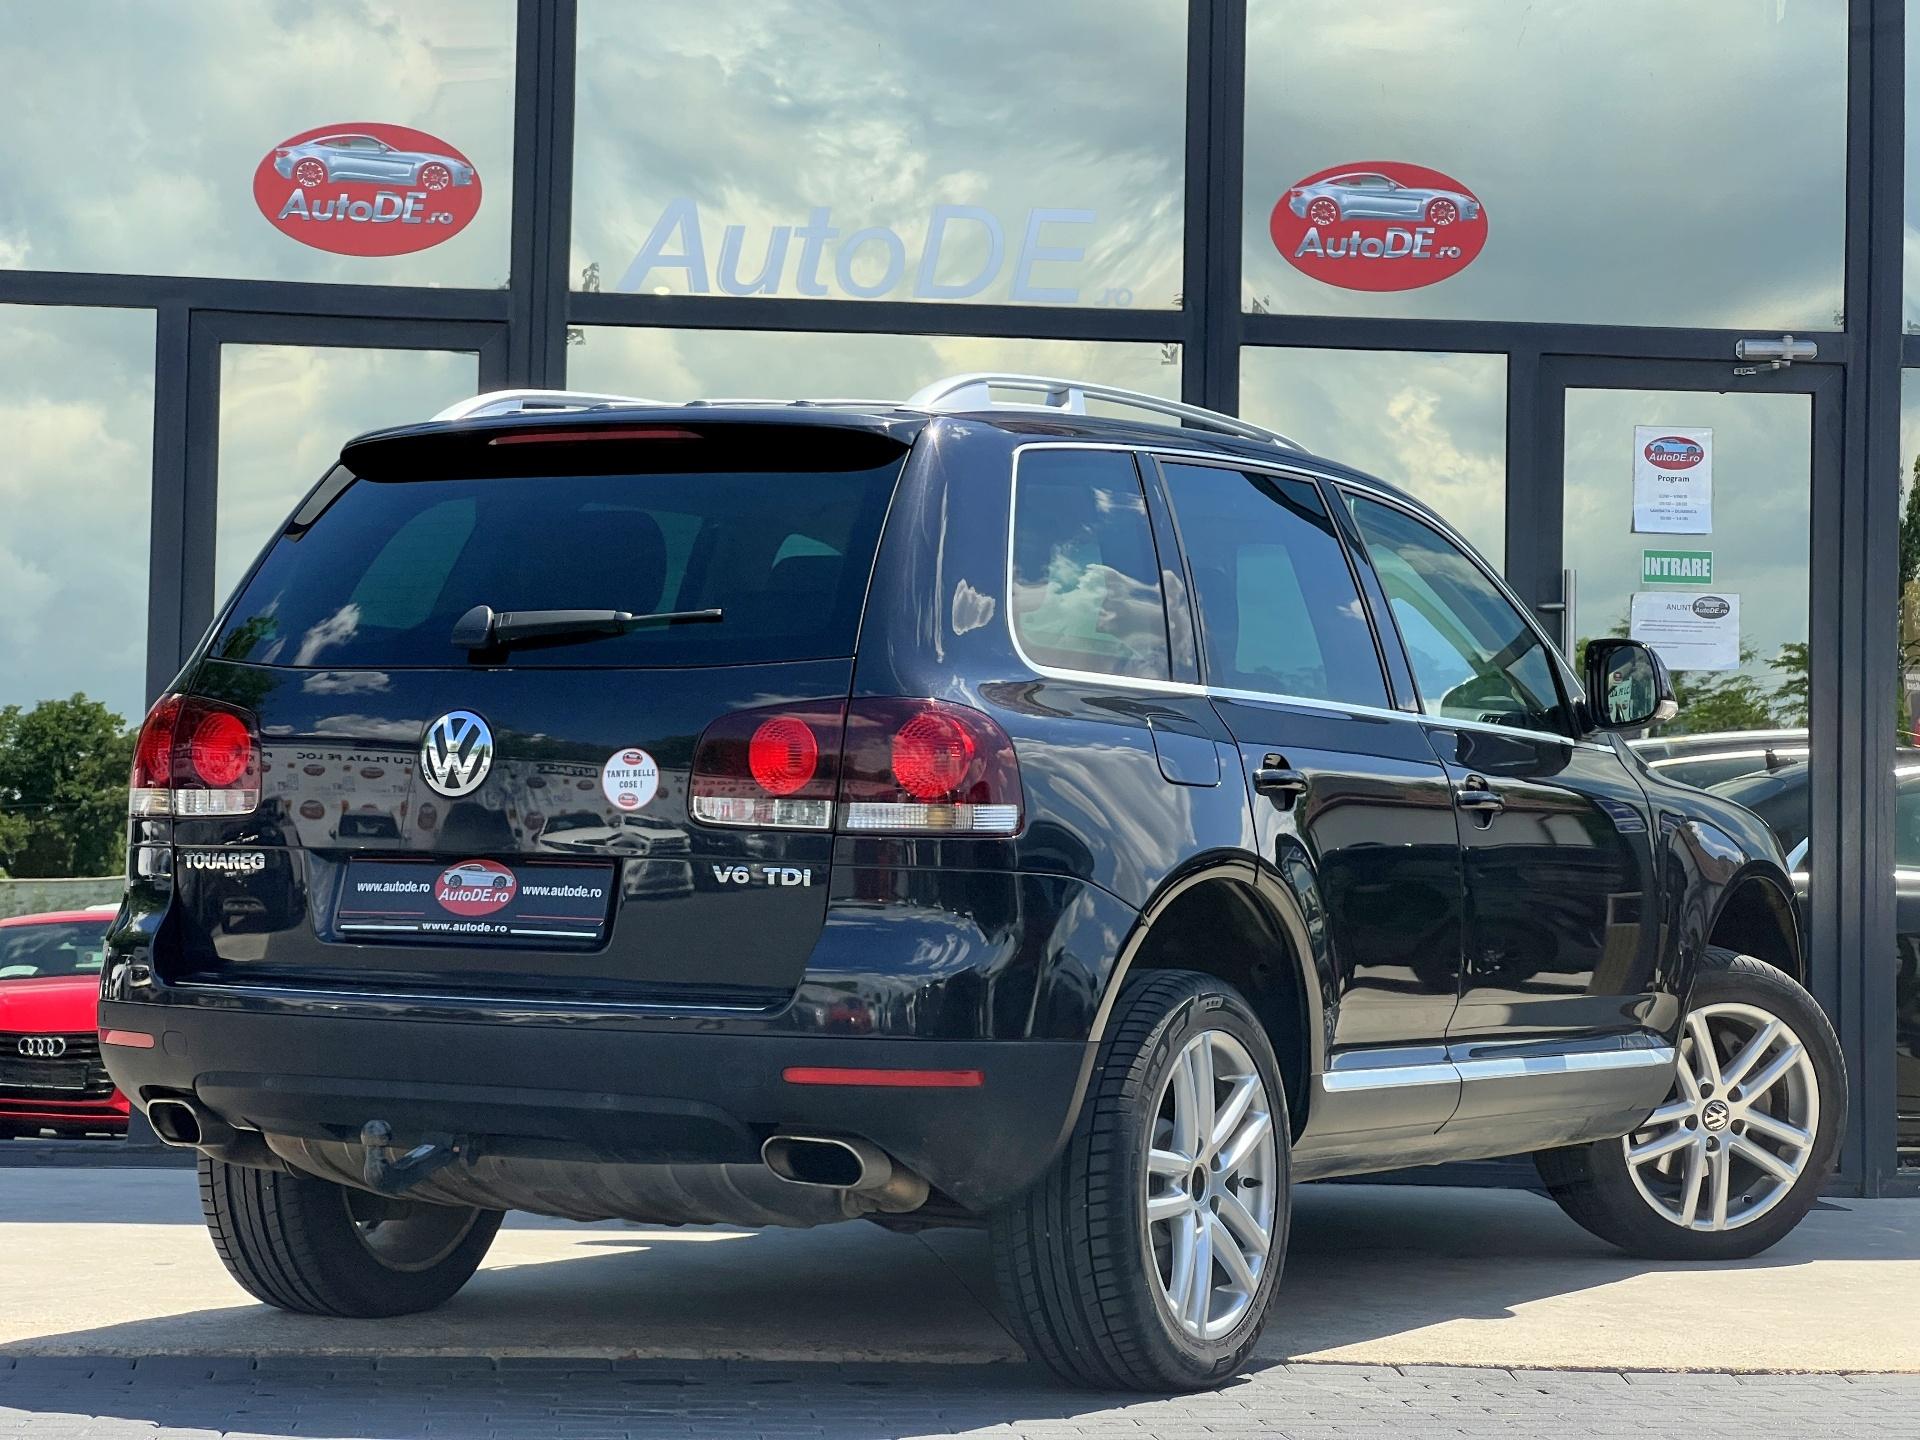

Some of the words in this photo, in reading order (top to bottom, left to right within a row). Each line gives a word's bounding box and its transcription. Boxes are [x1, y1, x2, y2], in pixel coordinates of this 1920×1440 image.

[278, 188, 453, 224] AutoDE.ro
[1295, 227, 1462, 259] AutoDE.ro
[1648, 452, 1700, 463] AutoDE.ro
[1657, 474, 1690, 483] Program
[1644, 557, 1710, 577] INTRARE
[607, 769, 631, 778] TANTE
[633, 769, 656, 777] BELLE
[619, 780, 638, 789] COSE
[184, 852, 265, 870] TOUAREG
[712, 865, 750, 884] V6
[762, 867, 811, 887] TDI
[357, 881, 430, 893] www.autode.ro
[522, 884, 602, 898] www.autode.ro
[438, 888, 509, 903] AutoDE.ro
[422, 922, 508, 933] www.autode.ro
